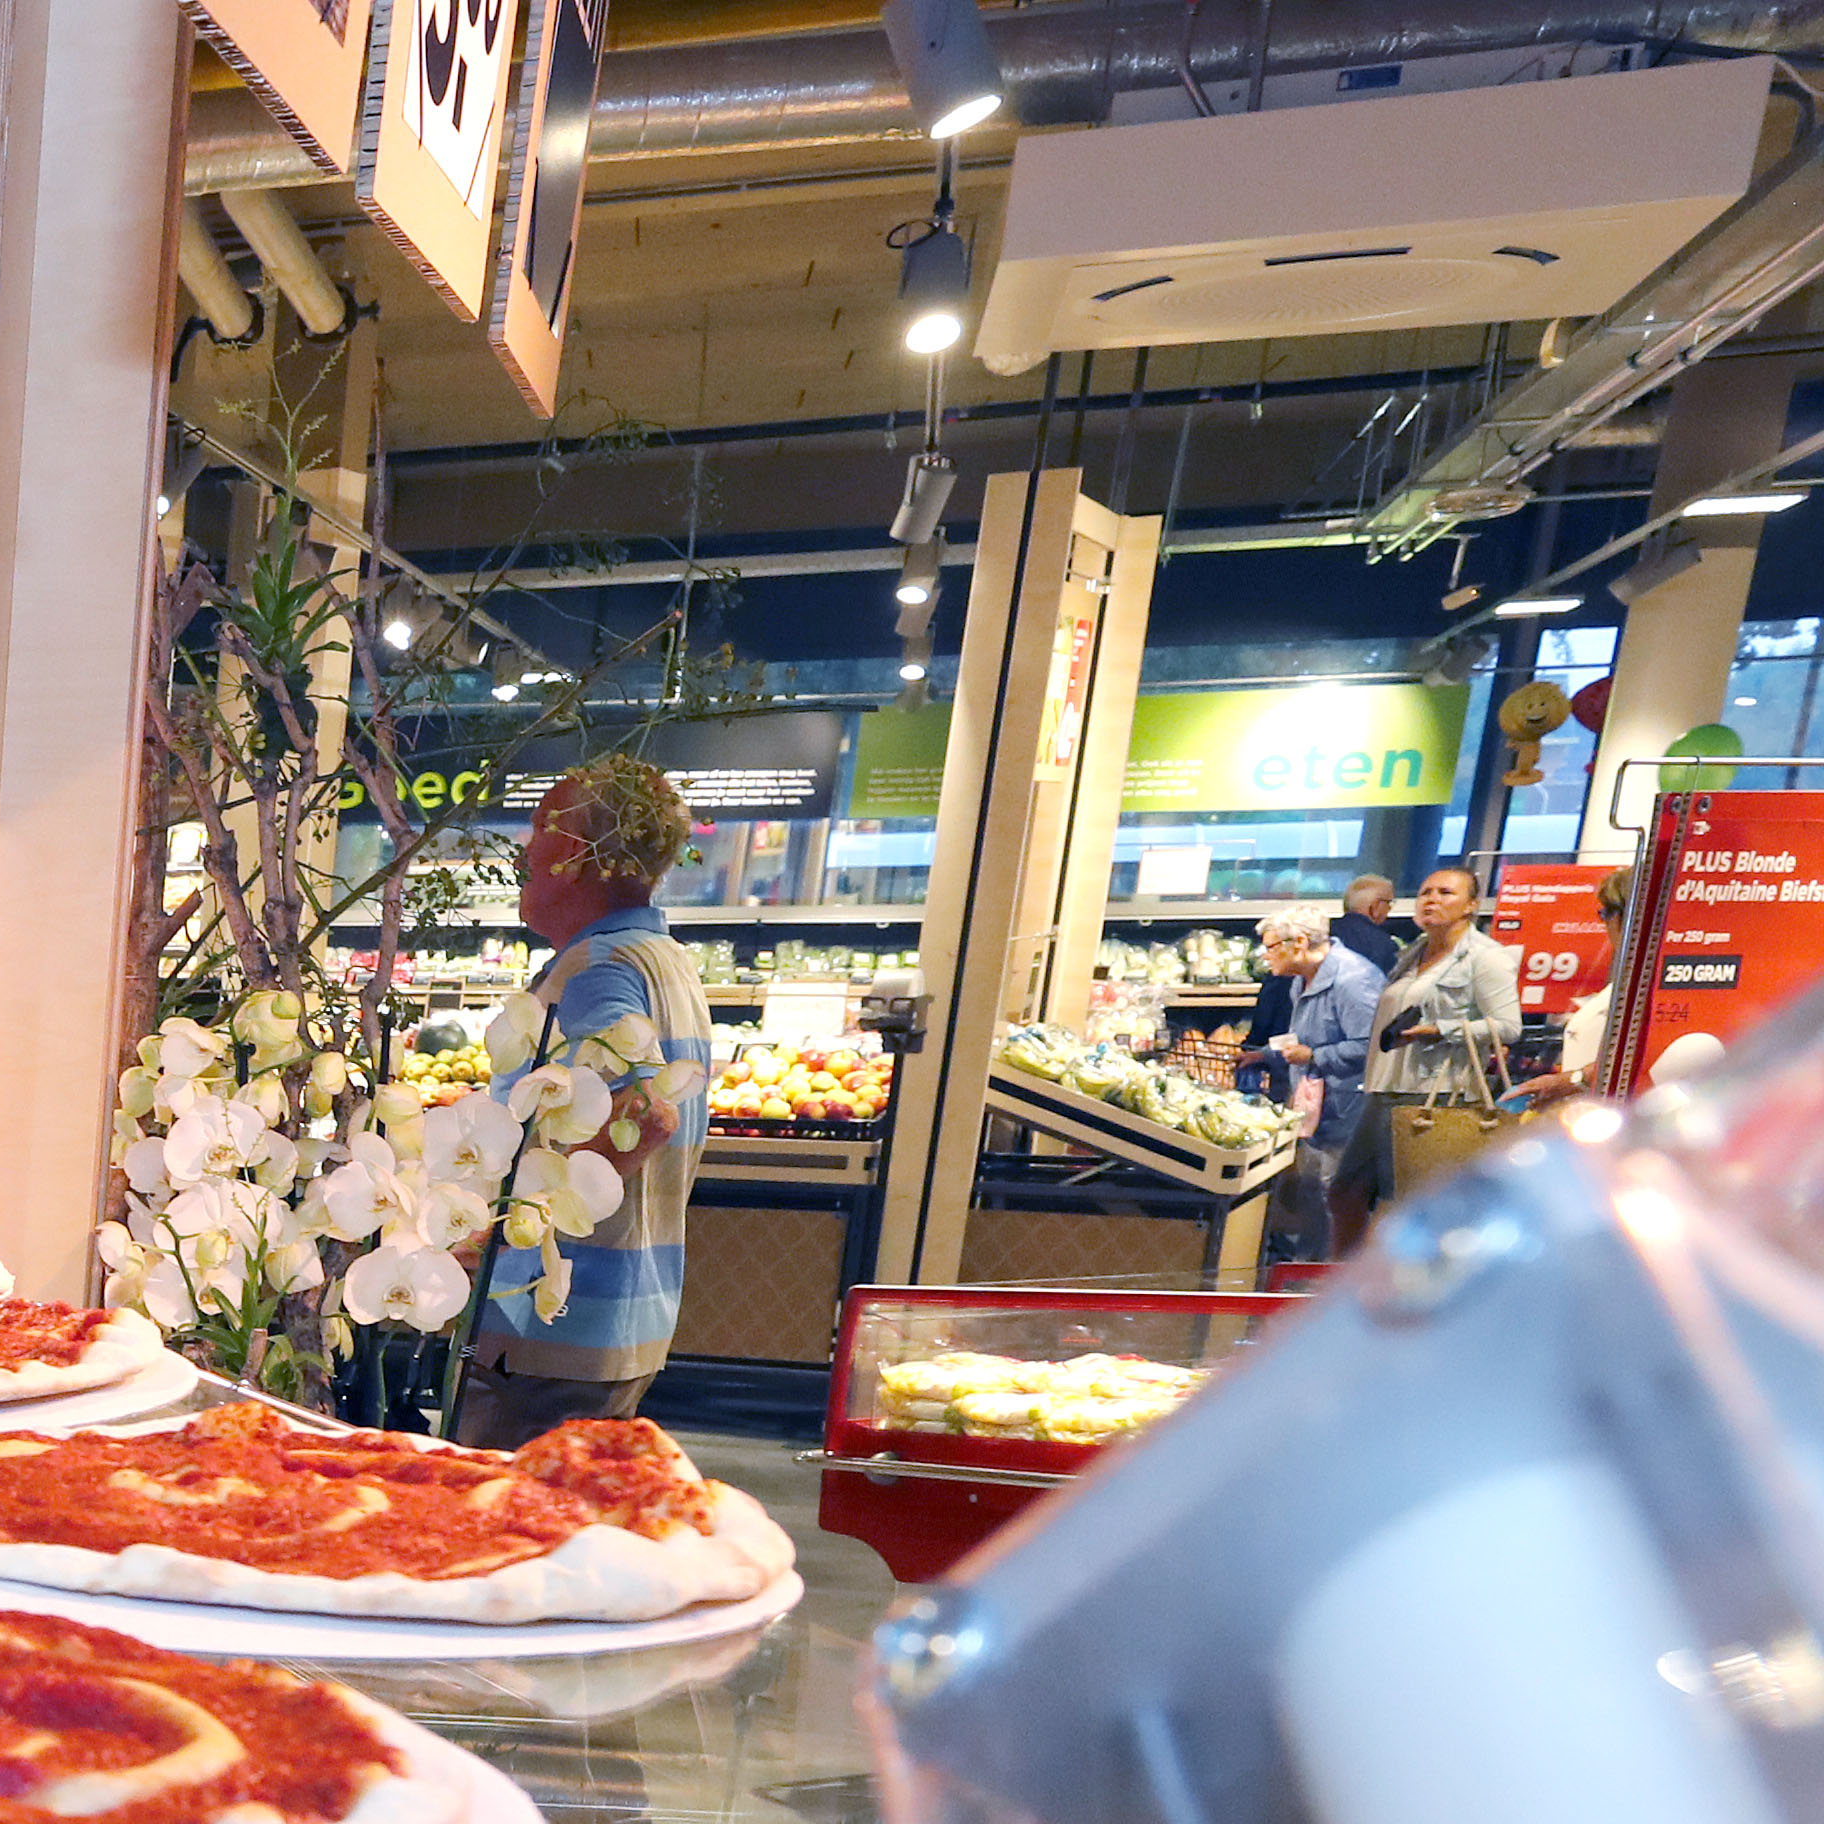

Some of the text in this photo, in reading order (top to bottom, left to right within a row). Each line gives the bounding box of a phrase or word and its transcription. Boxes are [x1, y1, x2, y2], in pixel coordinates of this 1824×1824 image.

[1254, 746, 1423, 791] eten
[1682, 850, 1796, 872] PLUS Blonde
[1675, 879, 1824, 905] d'Aquitaine Biefs
[1664, 964, 1737, 982] 250 GRAM
